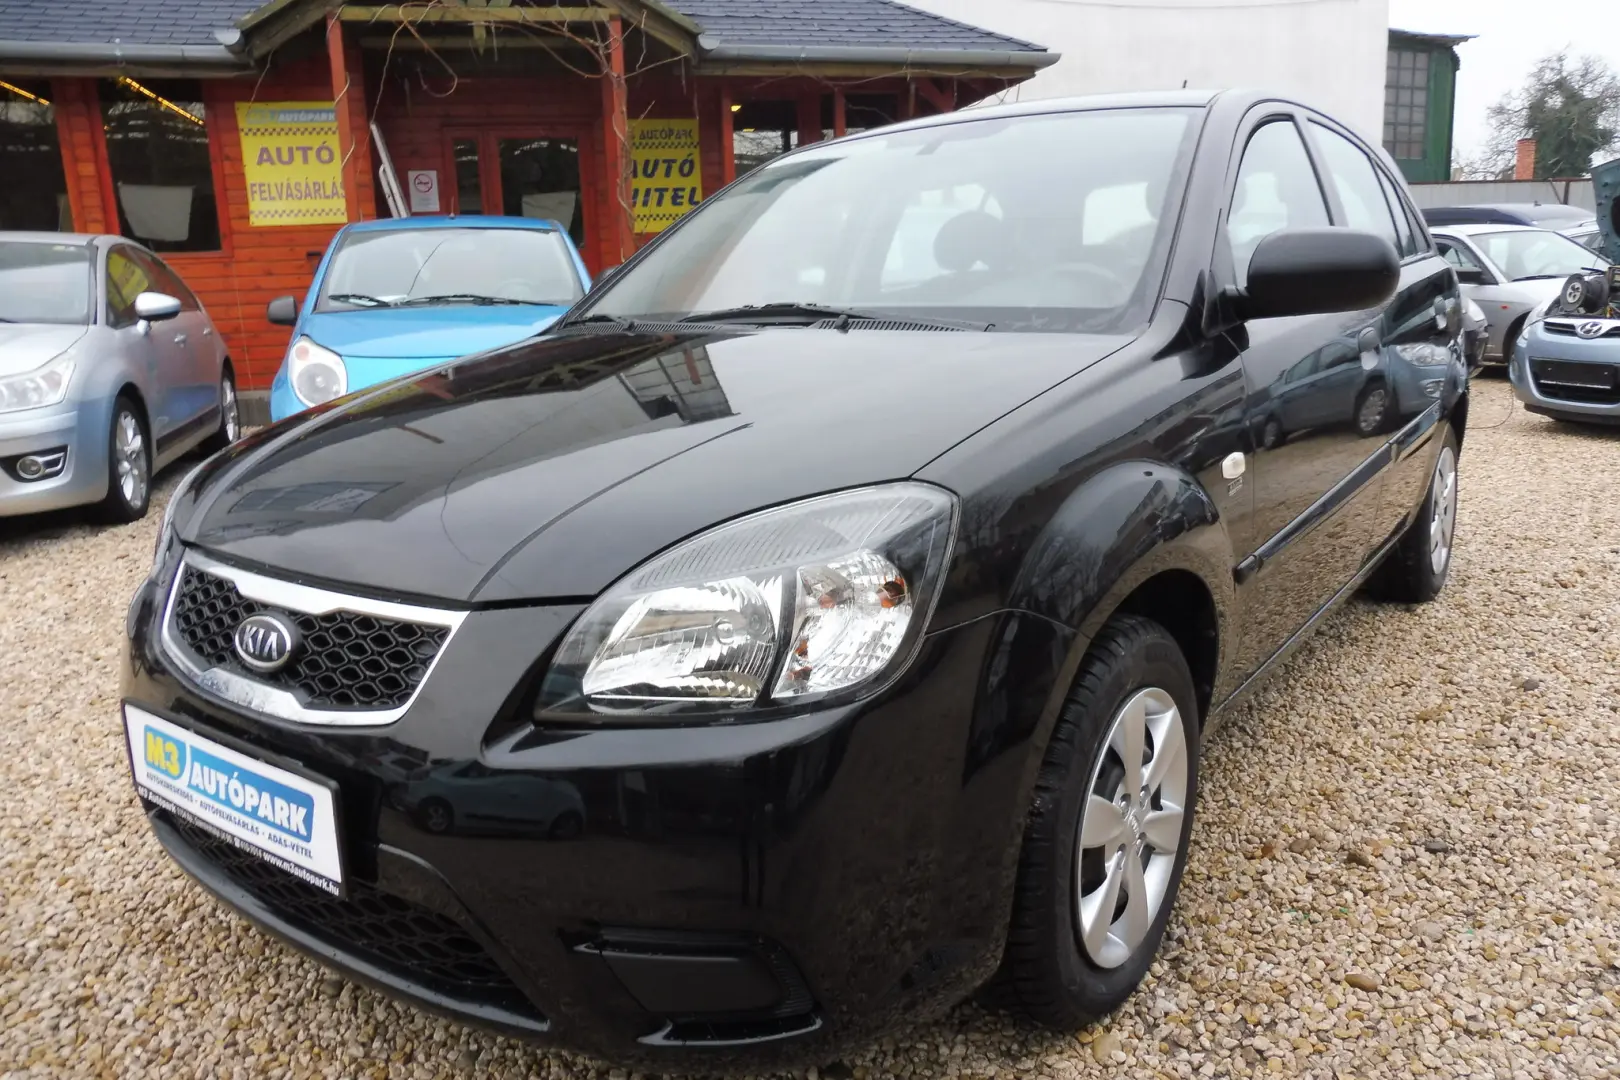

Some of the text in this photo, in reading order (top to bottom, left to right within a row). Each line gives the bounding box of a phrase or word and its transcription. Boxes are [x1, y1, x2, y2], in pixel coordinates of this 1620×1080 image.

[256, 141, 335, 166] AUTÓ
[242, 624, 278, 660] KIA
[145, 732, 181, 777] M3
[190, 761, 308, 837] AUTÓPARK
[262, 850, 340, 897] www.m3autopark.hu
